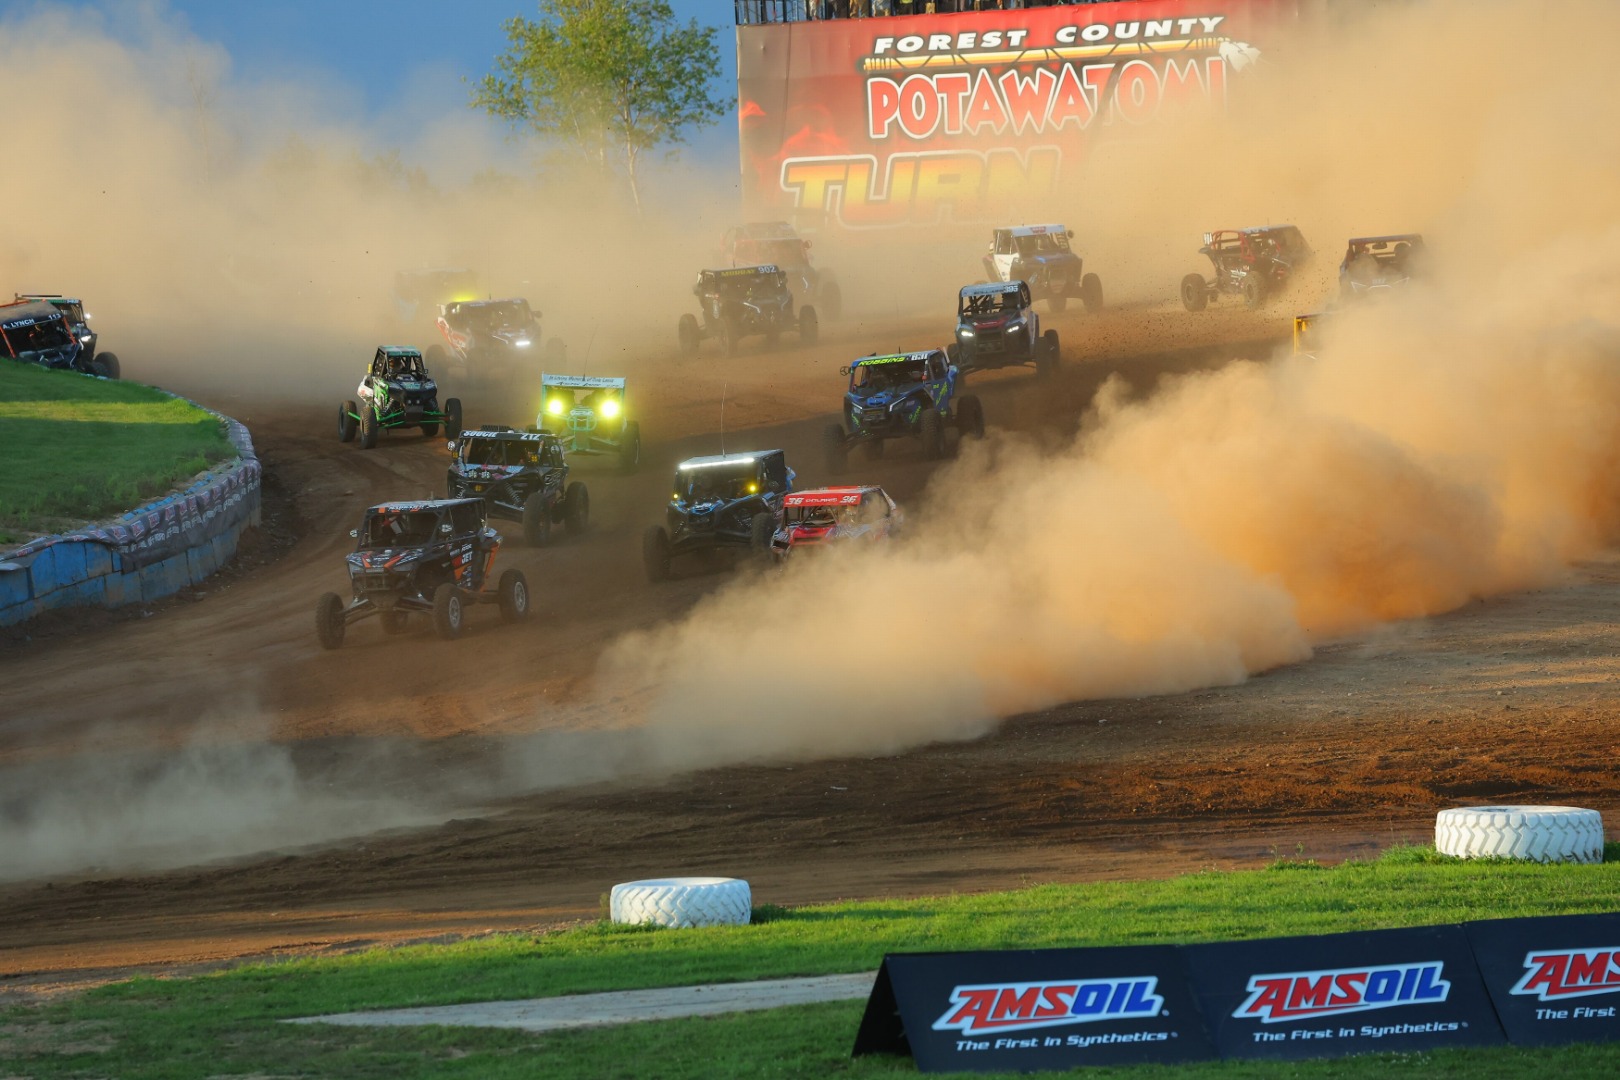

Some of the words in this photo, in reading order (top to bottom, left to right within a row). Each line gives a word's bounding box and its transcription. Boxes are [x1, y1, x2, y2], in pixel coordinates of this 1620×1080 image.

[874, 29, 1028, 54] FOREST
[1056, 16, 1224, 43] COUNTY
[867, 56, 1227, 139] POTAWATOMI
[780, 145, 1062, 230] TURN
[11, 318, 35, 328] LYNCH
[858, 356, 906, 366] ROBBINS
[944, 980, 1162, 1031] AMSOIL
[1244, 965, 1448, 1020] AMSOIL
[1536, 1008, 1569, 1020] The
[1573, 1006, 1617, 1019] First
[956, 1040, 990, 1052] The
[994, 1037, 1039, 1050] First
[1044, 1036, 1061, 1047] in
[1066, 1031, 1168, 1048] Synthetics
[1253, 1031, 1286, 1042] The
[1291, 1028, 1334, 1041] First
[1339, 1027, 1356, 1038] in
[1360, 1021, 1459, 1038] Synthetics
